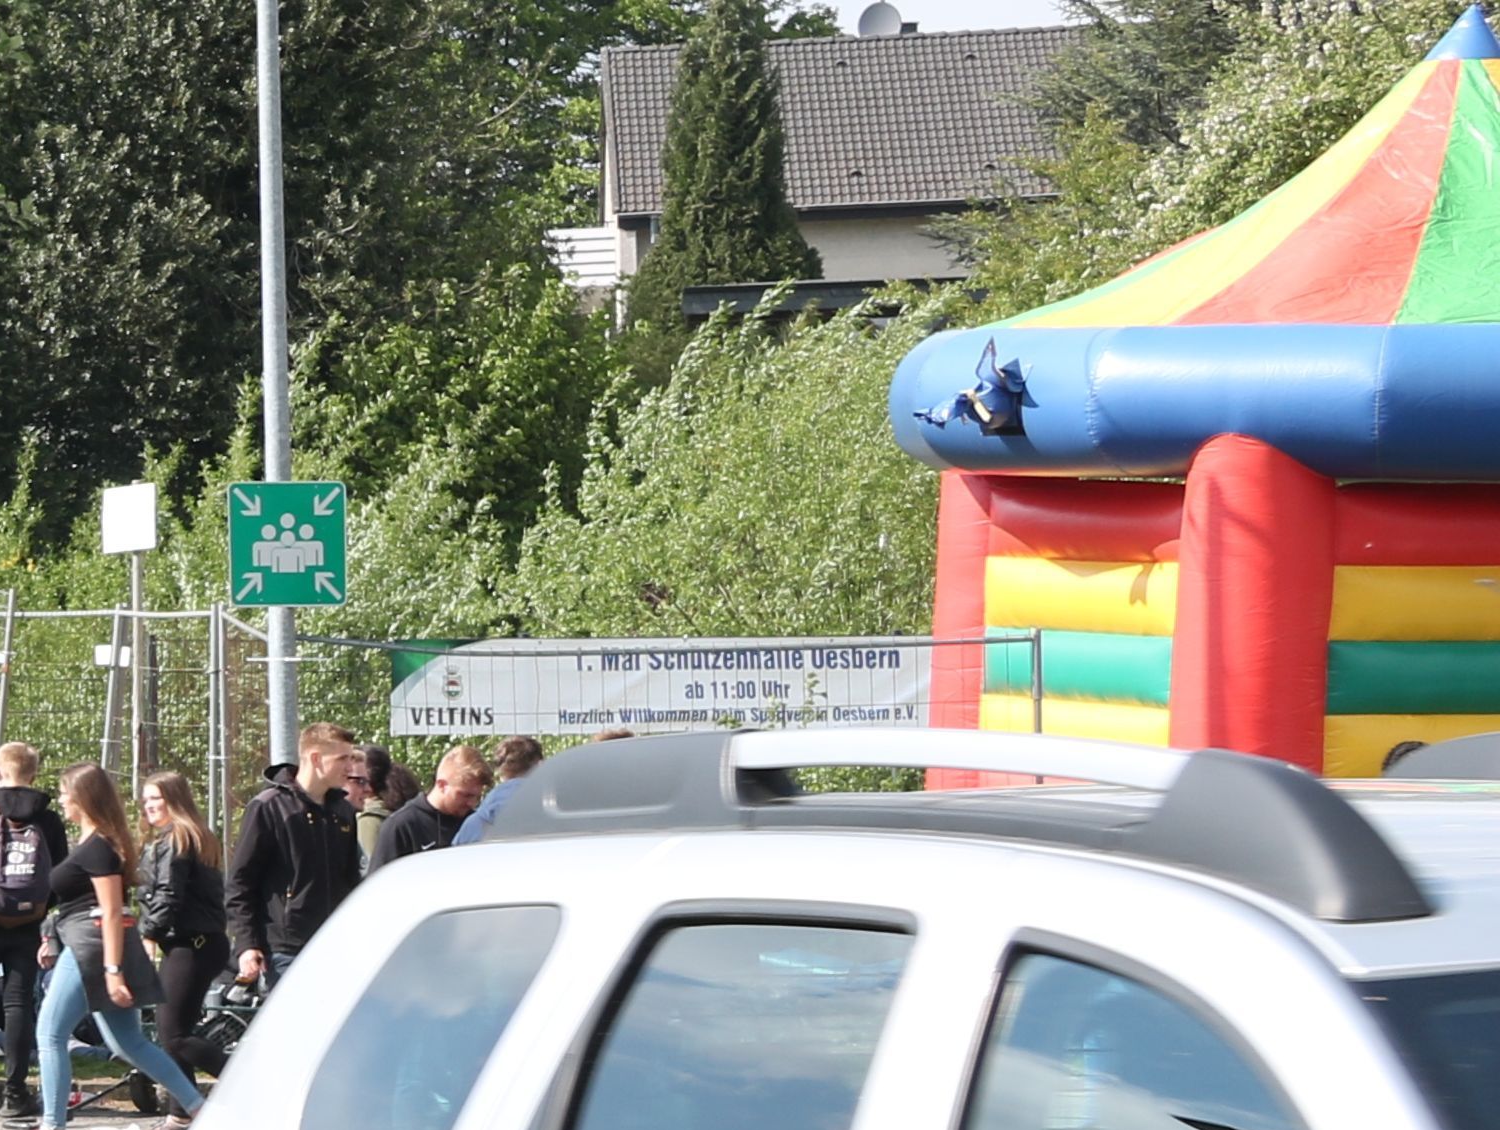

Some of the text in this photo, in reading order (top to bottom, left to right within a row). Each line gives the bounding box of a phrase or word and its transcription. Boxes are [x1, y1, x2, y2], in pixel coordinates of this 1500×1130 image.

[811, 645, 900, 670] Oesbern
[685, 680, 790, 699] ab 11:00 Uhr
[411, 707, 494, 726] VELTINS
[558, 709, 614, 725] Herzlich
[619, 707, 707, 723] Willkommen
[833, 706, 889, 721] Oesbern
[895, 704, 919, 720] e.V.
